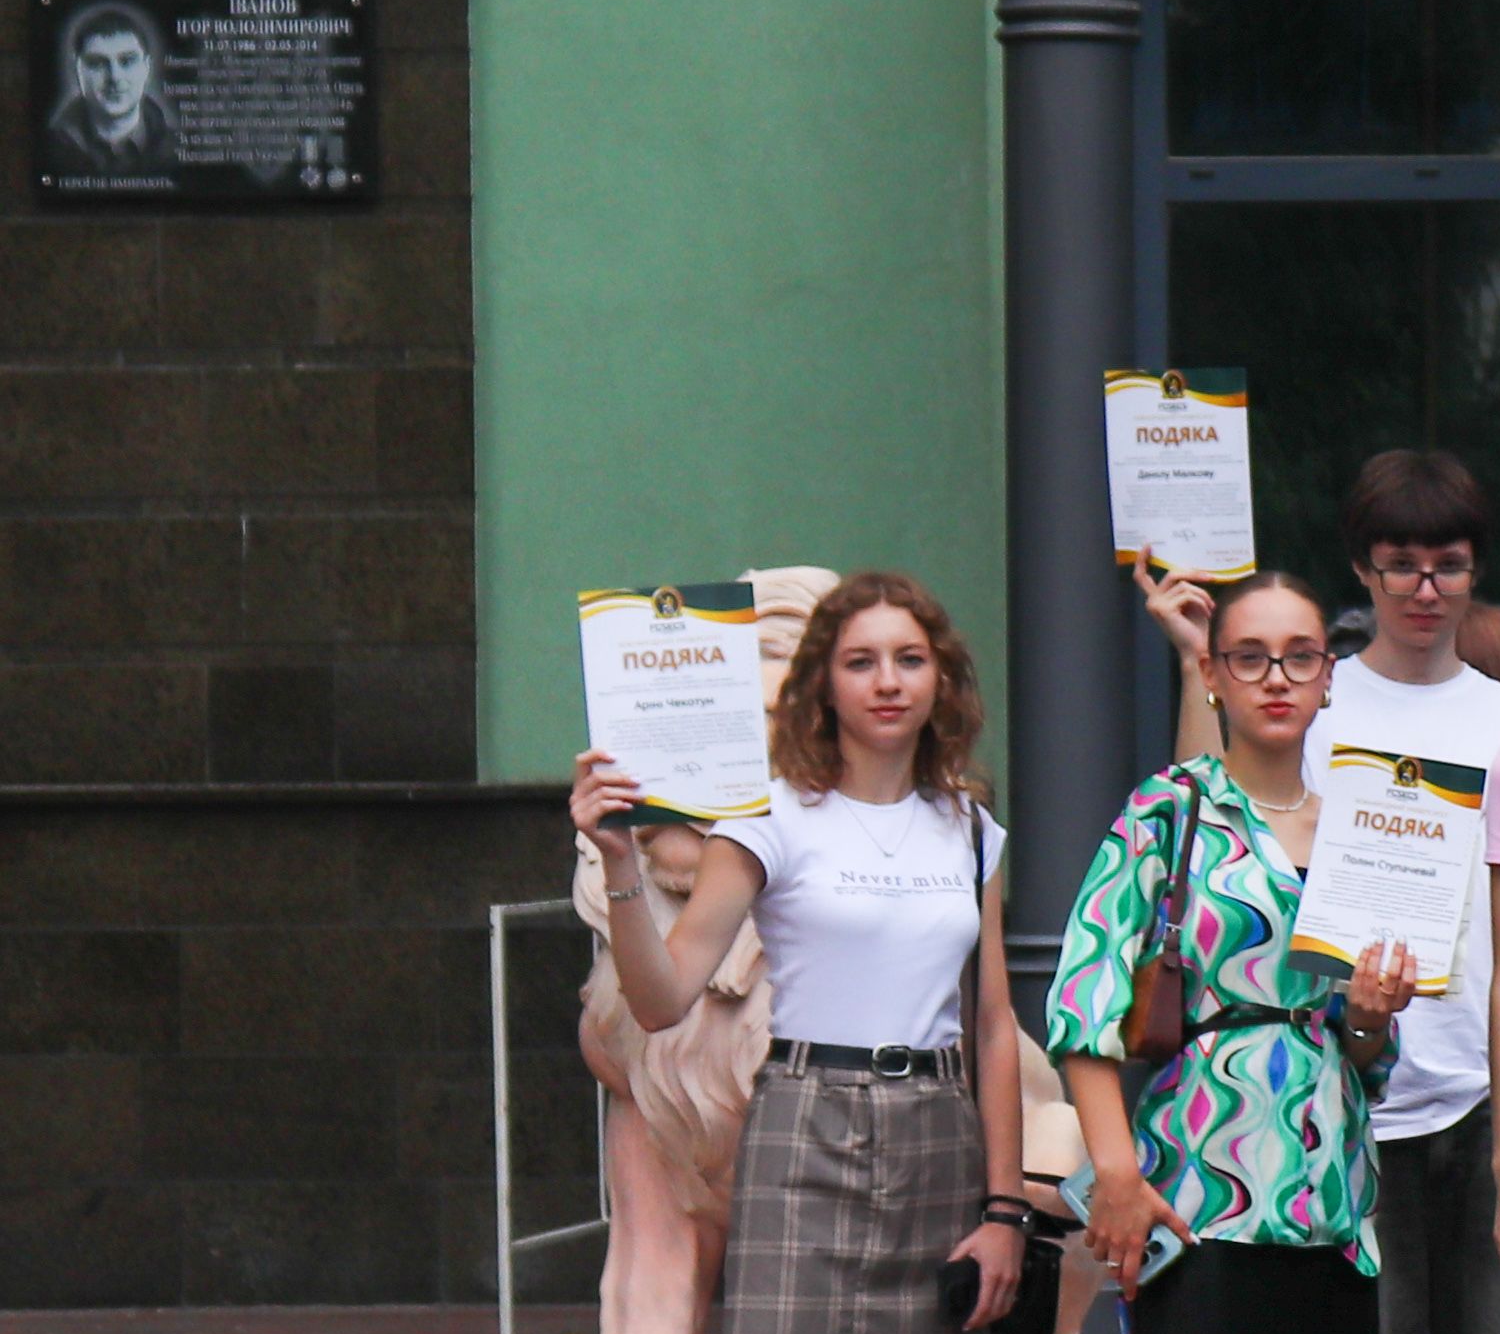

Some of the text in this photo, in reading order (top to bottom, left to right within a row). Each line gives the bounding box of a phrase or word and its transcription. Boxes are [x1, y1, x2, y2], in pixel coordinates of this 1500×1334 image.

[214, 18, 350, 35] ВОЛОДИМИРОВИЧ
[1135, 425, 1218, 447] ПОДЯКА
[622, 645, 726, 672] ПОДЯКА
[1353, 809, 1448, 840] ПОДЯКА
[839, 870, 964, 888] Never mind
